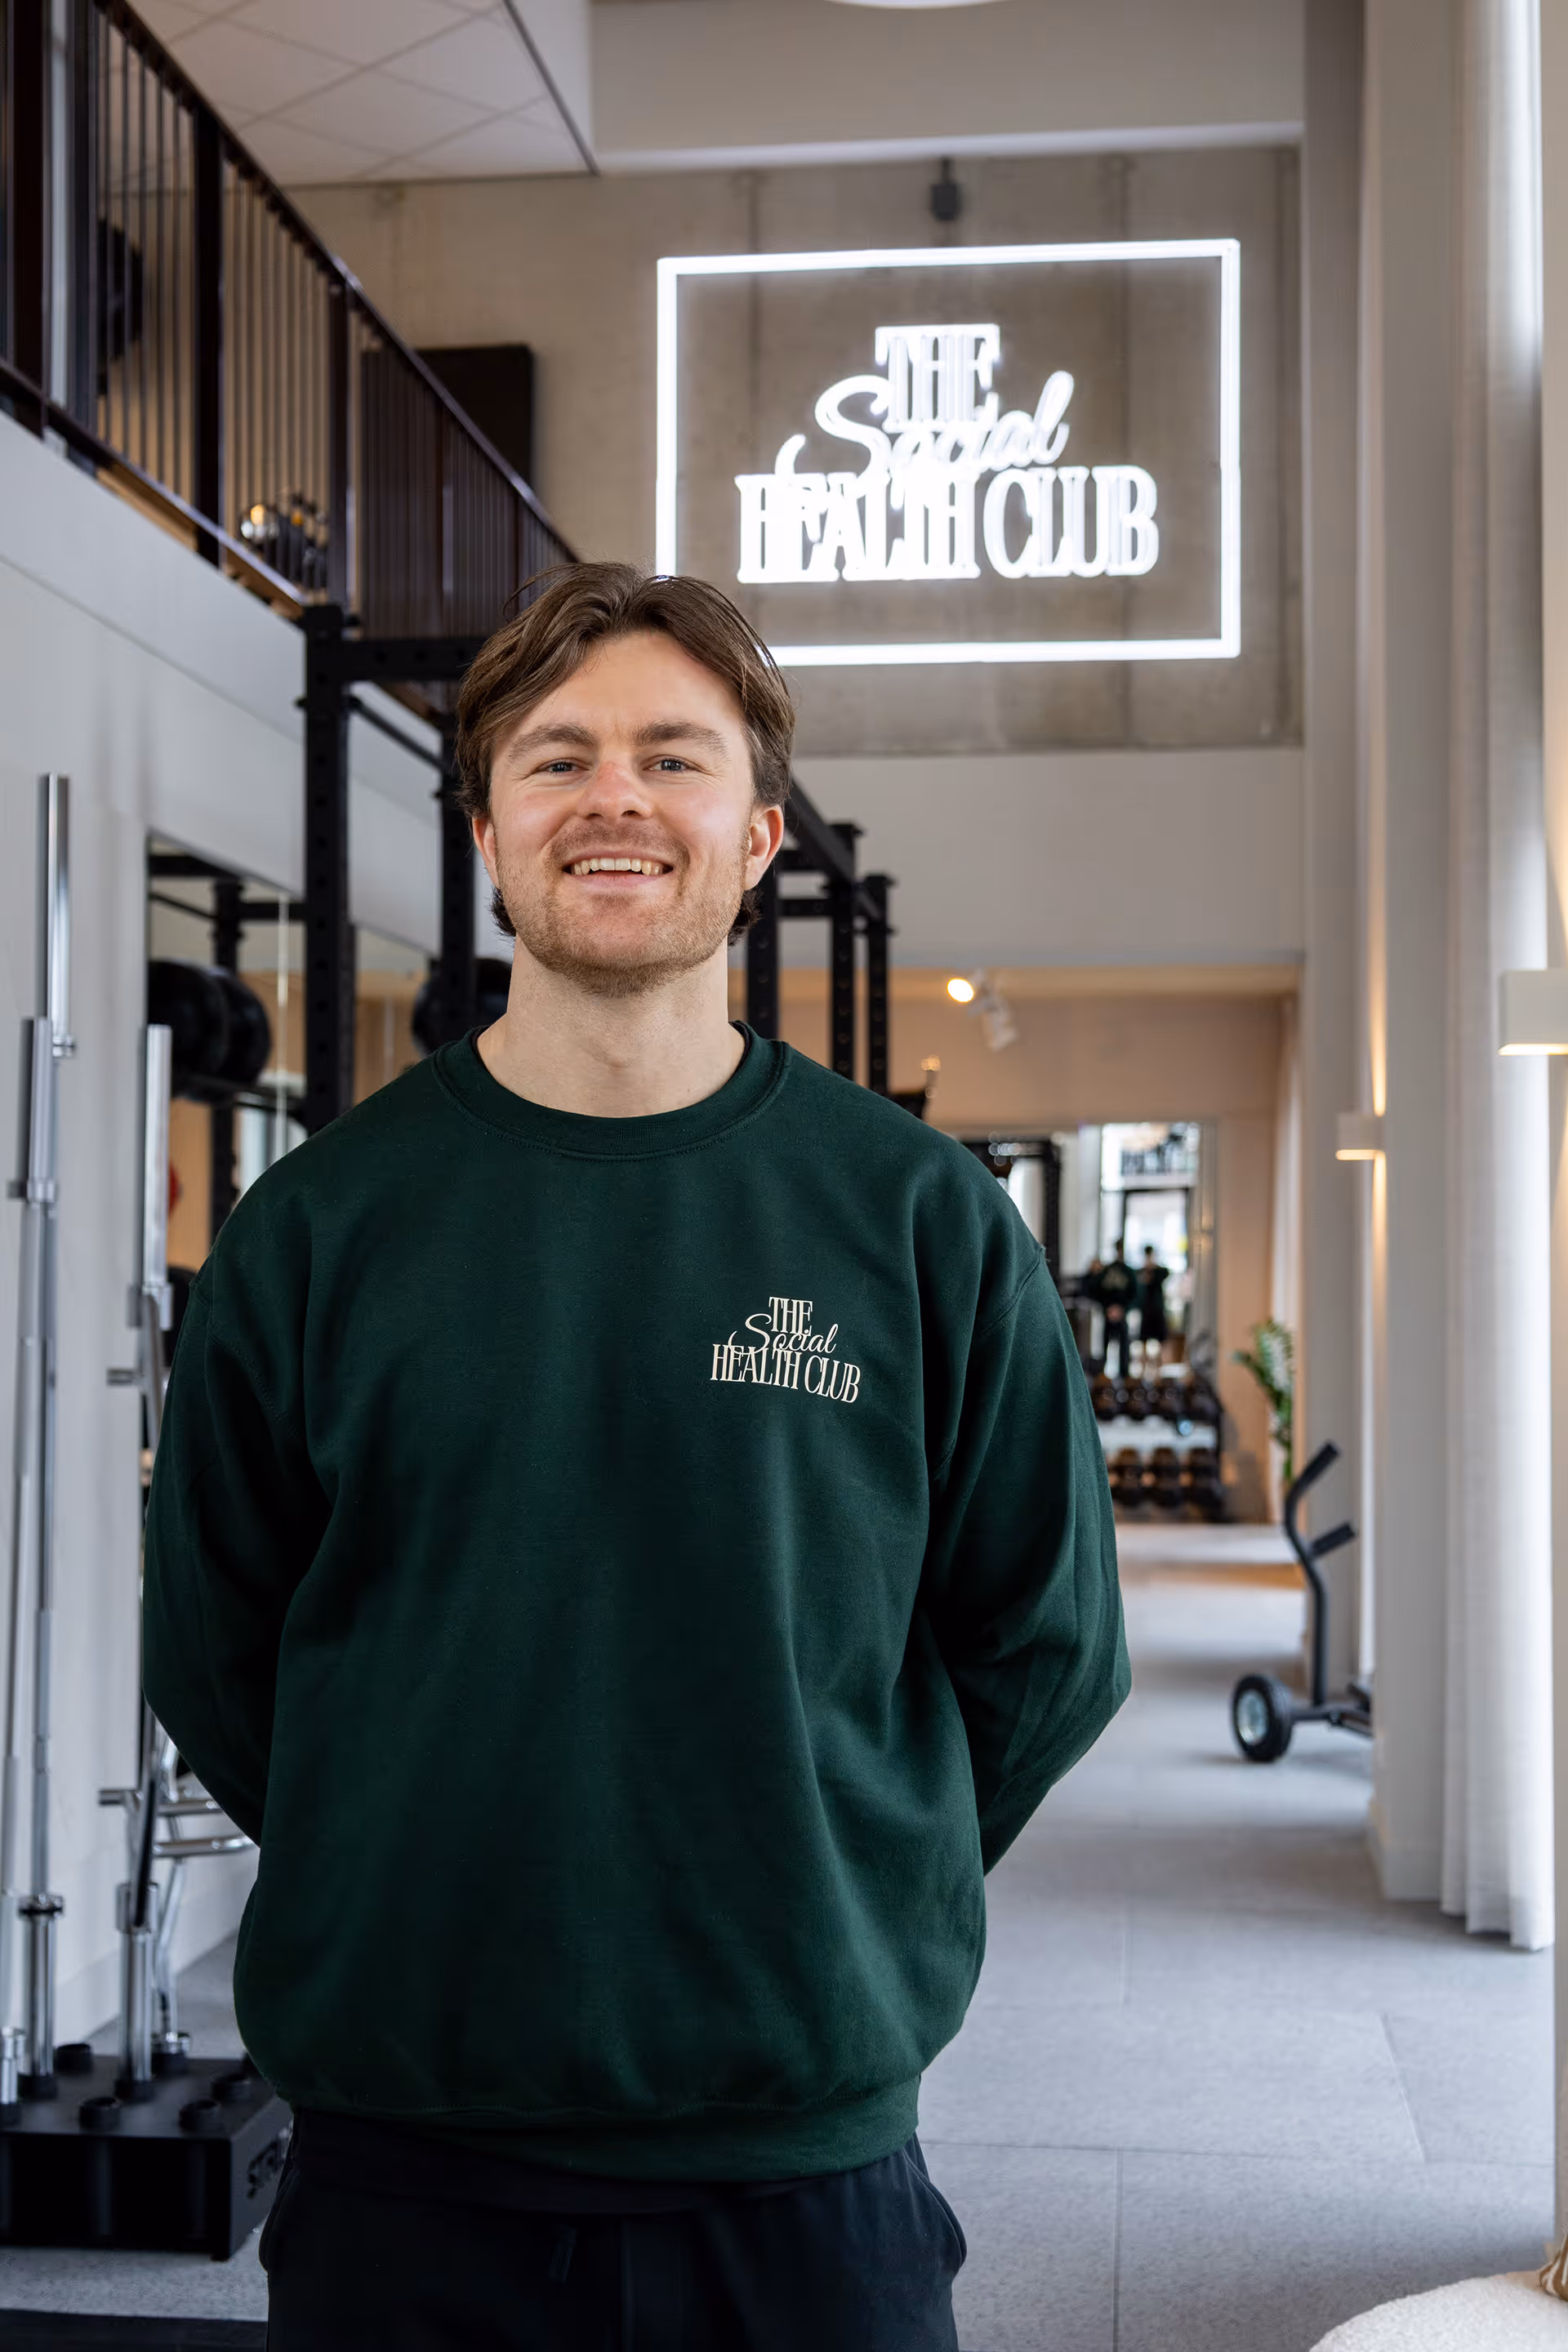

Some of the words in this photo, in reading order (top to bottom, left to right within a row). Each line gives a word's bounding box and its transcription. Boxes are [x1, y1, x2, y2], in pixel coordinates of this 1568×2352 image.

[875, 323, 1000, 433] THE
[774, 371, 1075, 488] Social
[735, 471, 981, 583] HEALTH
[982, 466, 1160, 578] CLUB
[728, 1313, 839, 1354] Social
[768, 1296, 813, 1337] THE
[710, 1343, 802, 1389] HEALTH
[804, 1355, 861, 1404] CLUB
